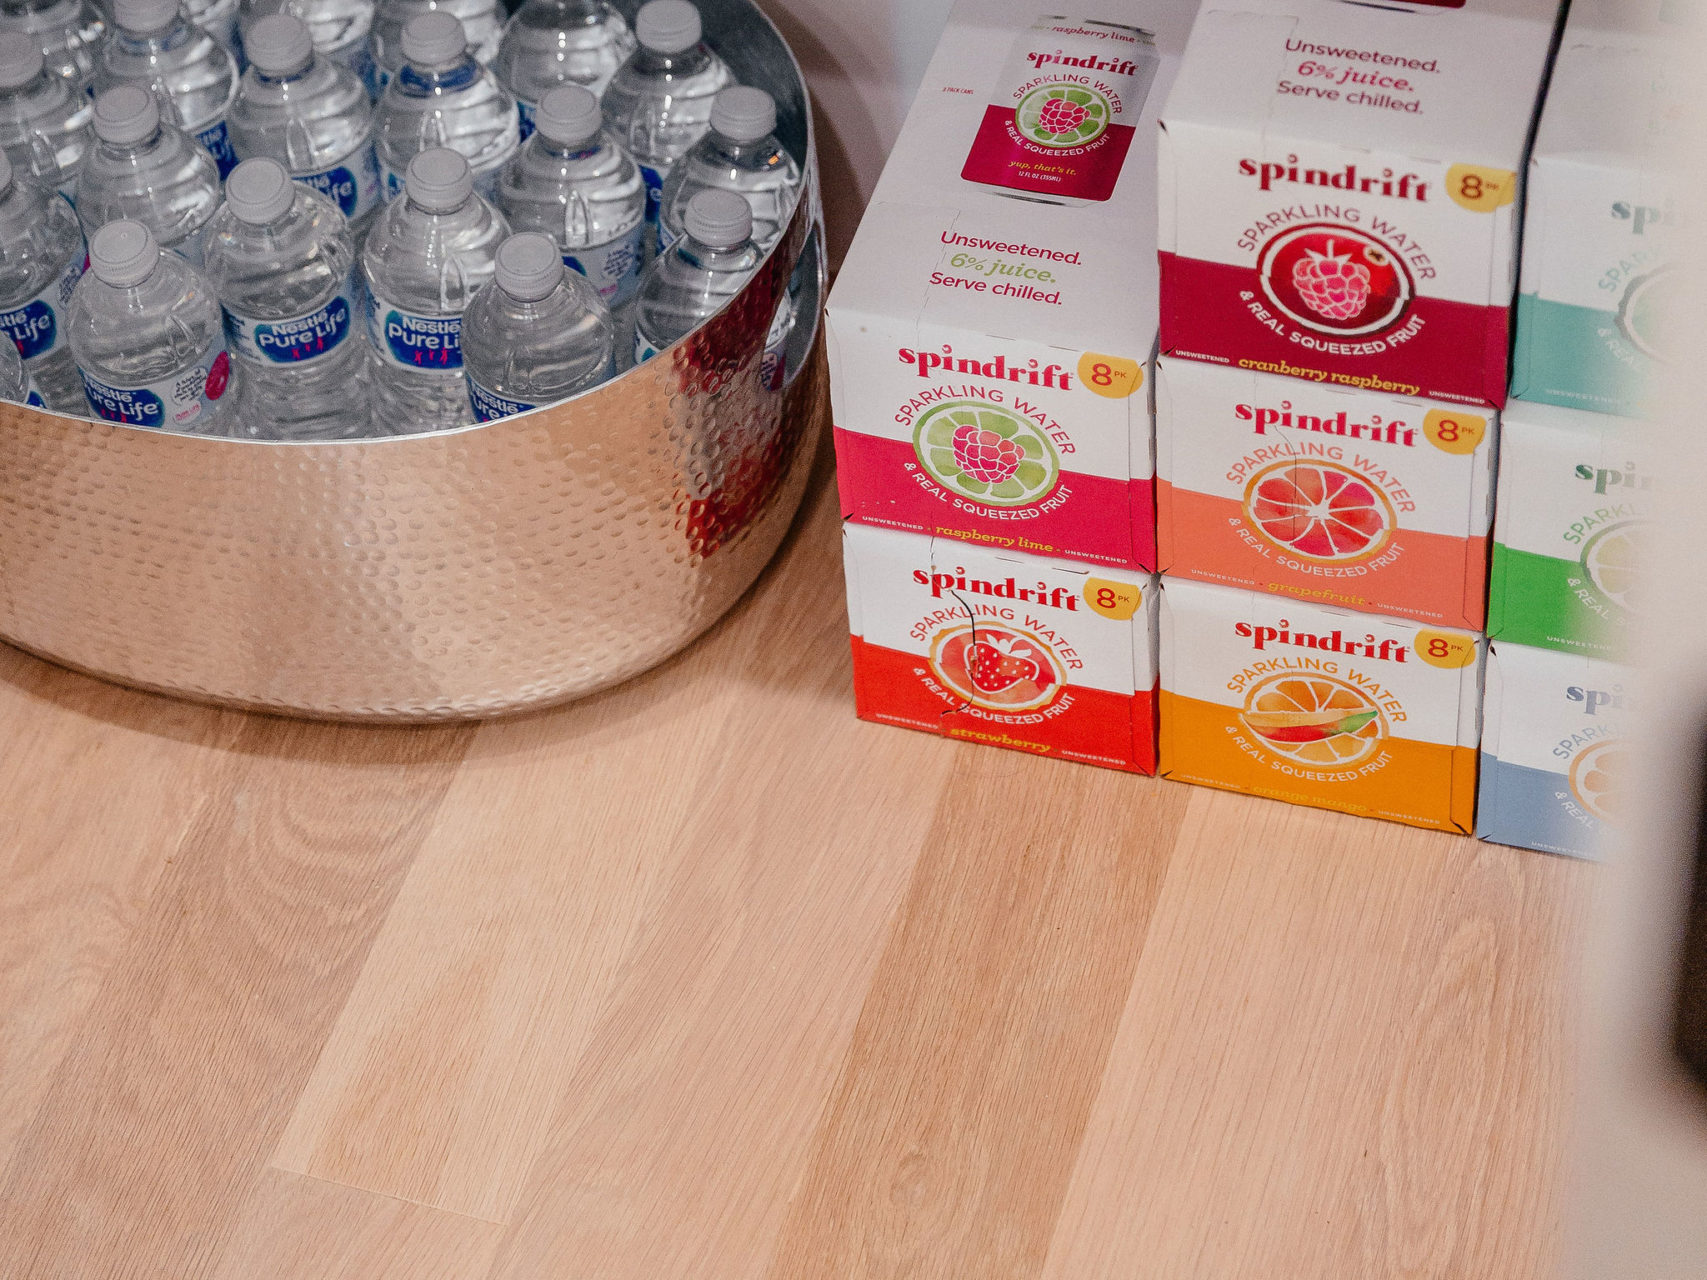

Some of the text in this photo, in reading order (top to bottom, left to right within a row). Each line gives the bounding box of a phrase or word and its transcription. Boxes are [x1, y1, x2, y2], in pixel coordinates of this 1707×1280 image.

[1051, 25, 1136, 44] raspberry lime
[1284, 37, 1441, 74] Unsweetened.
[1026, 49, 1138, 76] spindrift
[1297, 60, 1415, 93] 6% juice.
[1013, 73, 1124, 115] SPARKLING WATER
[1276, 79, 1424, 115] Serve chilled.
[1005, 126, 1022, 146] REAL
[1023, 141, 1085, 157] SQUEEZED
[1086, 133, 1111, 153] FRUIT
[1008, 160, 1031, 170] yup,
[1033, 163, 1065, 174] that's
[1238, 153, 1431, 203] spindrift
[1460, 173, 1484, 200] 8
[940, 230, 1083, 266] Unsweetened.
[1237, 204, 1437, 282] SPARKLING WATER
[929, 271, 1063, 306] Serve chilled.
[949, 252, 1057, 284] 6% juice.
[14, 314, 49, 341] Life
[258, 328, 313, 349] Pure
[314, 307, 347, 339] Life
[271, 309, 329, 335] Nestlé
[388, 322, 460, 350] Pure Li
[1239, 289, 1427, 356] & REAL SQUEEZED FRUIT
[898, 343, 1075, 391] spindrift
[1091, 362, 1127, 387] 8 PK
[1174, 349, 1486, 405] UNSWEETENED cranberry raspberry UNSWEETENED
[120, 401, 160, 421] Life
[894, 384, 1076, 456] SPARKLING WATER
[1235, 400, 1418, 448] spindrift
[1437, 419, 1476, 442] 8 PK
[904, 461, 1074, 521] & REAL SQUEEZED FRUIT
[1226, 441, 1416, 514] SPARKLING WATER
[861, 515, 1128, 565] UNSWEETENED raspberry lime UNSWEETENED
[1563, 503, 1643, 545] SPARKL
[1228, 516, 1407, 578] & REAL SQUEEZED FRUIT
[912, 566, 1081, 612] spindrift
[1096, 587, 1130, 610] 8 PK
[1190, 568, 1444, 619] UNSWEETENED grapefruit UNSWEETENED
[1567, 576, 1610, 621] & REAL
[910, 603, 1084, 671] SPARKLING WATER
[1234, 618, 1410, 664] spindrift
[1427, 637, 1464, 658] 8 PK
[913, 666, 1077, 726] & REAL SQUEEZED FRUIT
[1226, 656, 1408, 724] SPARKLING WATER
[875, 712, 1127, 766] UNSWEETENED strawberry UNSWEETENED
[1225, 725, 1395, 783] & REAL SQUEEZED FRUIT
[1252, 784, 1310, 803] orange
[1311, 795, 1368, 813] mango
[1554, 790, 1595, 830] & REAL
